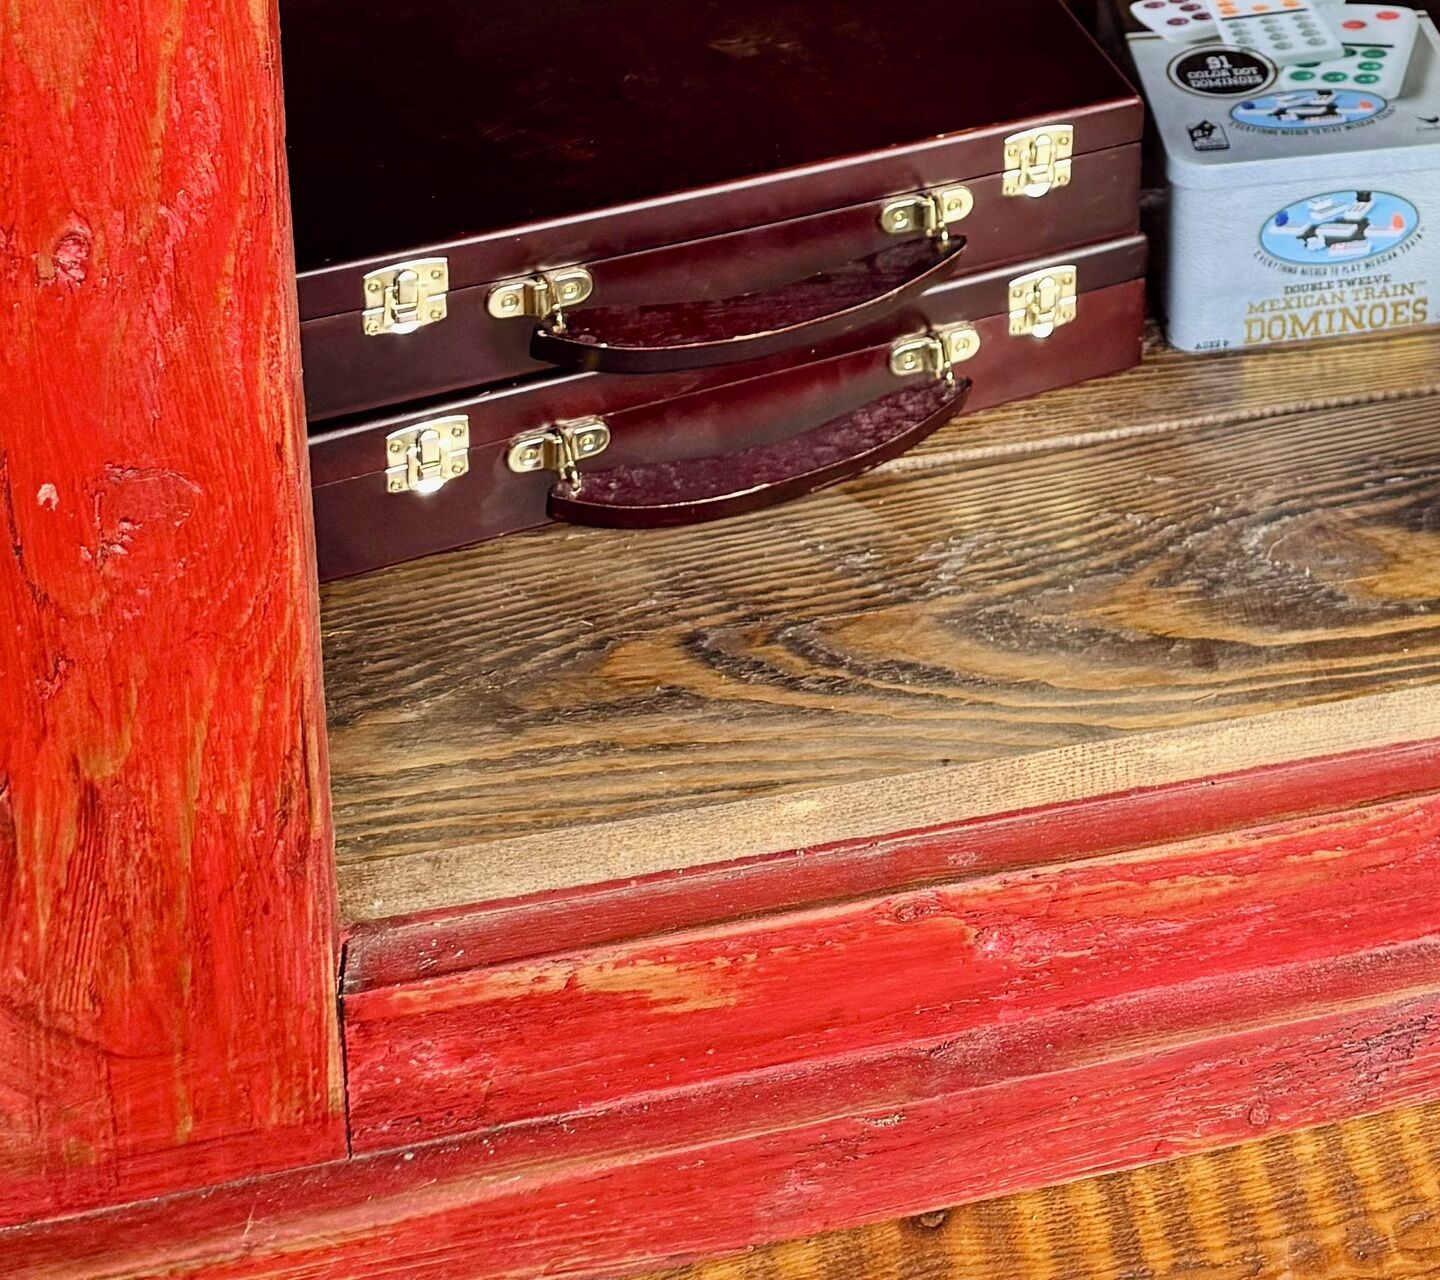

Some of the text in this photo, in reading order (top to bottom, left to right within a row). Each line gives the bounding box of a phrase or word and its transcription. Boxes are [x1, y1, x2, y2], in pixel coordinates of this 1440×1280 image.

[1205, 55, 1233, 70] 91
[1234, 66, 1258, 76] DOT
[1190, 75, 1264, 89] DOMINOES
[1341, 264, 1361, 274] PLAY
[1284, 274, 1392, 295] DOUBLE TWELVE
[1247, 282, 1415, 315] MEXICAN TRAIN
[1244, 297, 1429, 344] DOMINOES
